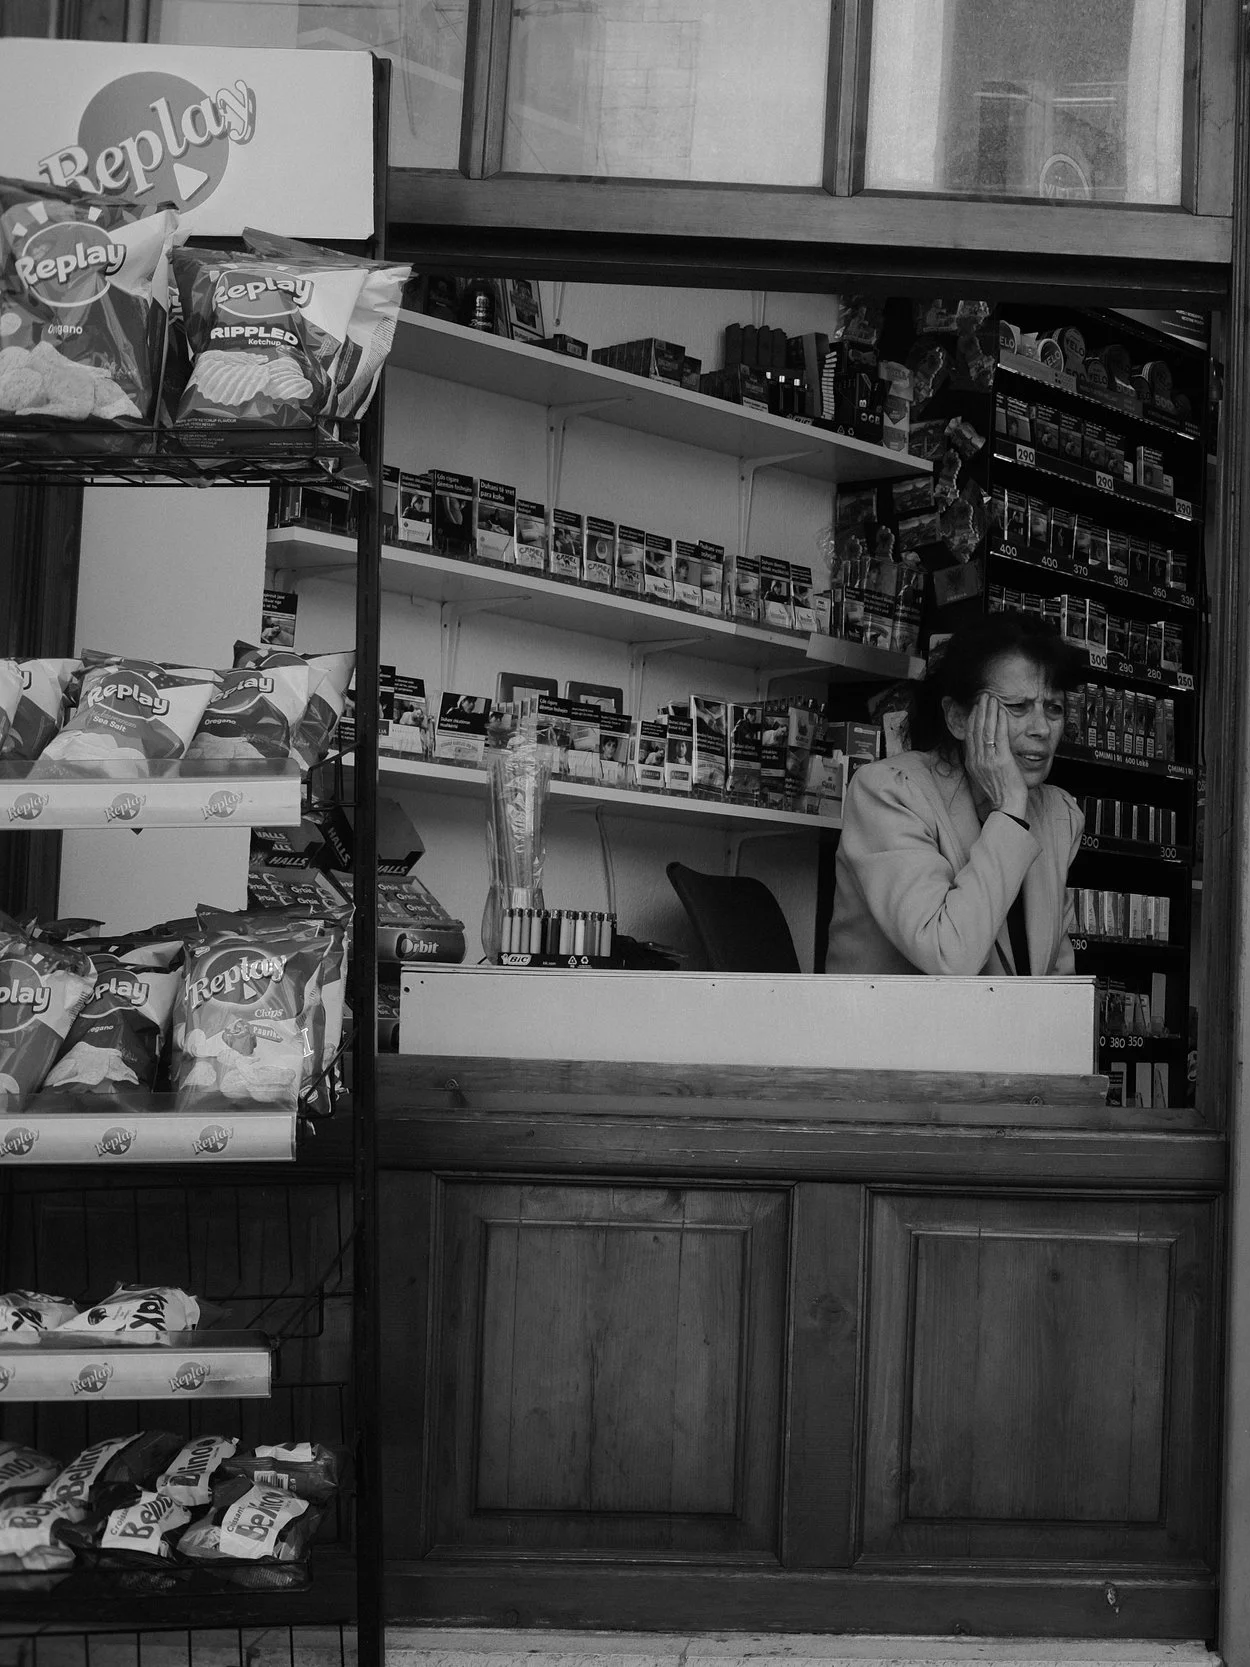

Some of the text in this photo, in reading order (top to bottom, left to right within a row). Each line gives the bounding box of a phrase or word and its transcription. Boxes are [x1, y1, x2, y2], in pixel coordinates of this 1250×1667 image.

[39, 79, 257, 196] Replay
[15, 241, 126, 288] Replay
[210, 325, 299, 346] RIPPLED
[247, 337, 282, 347] Ketchup
[1018, 449, 1035, 464] 290
[1097, 474, 1113, 489] 290
[1177, 501, 1191, 515] 290
[1000, 544, 1017, 557] 400
[1041, 556, 1058, 569] 400
[1073, 564, 1088, 577] 370
[1113, 575, 1129, 588] 380
[1152, 586, 1167, 599] 350
[1090, 654, 1107, 667] 300
[1118, 662, 1134, 674] 290
[1147, 668, 1162, 680] 280
[1178, 674, 1193, 687] 250
[88, 680, 170, 717] Replay
[93, 715, 109, 725] Sea
[109, 722, 127, 733] Salt
[204, 718, 237, 726] Oregano
[1125, 757, 1136, 765] 600
[6, 792, 51, 822] Replay
[104, 793, 147, 823] Replay
[200, 791, 244, 822] Replay
[326, 826, 352, 868] HALLS
[268, 855, 310, 867] HALLS
[401, 937, 440, 955] Orbit
[189, 955, 288, 1011] Replay
[254, 1008, 284, 1019] Chips
[1109, 1036, 1126, 1049] 380
[1127, 1035, 1144, 1048] 350
[94, 1128, 138, 1157] Replay
[191, 1125, 235, 1155] Replay
[72, 1362, 114, 1396] Replay
[168, 1360, 212, 1393] Replay
